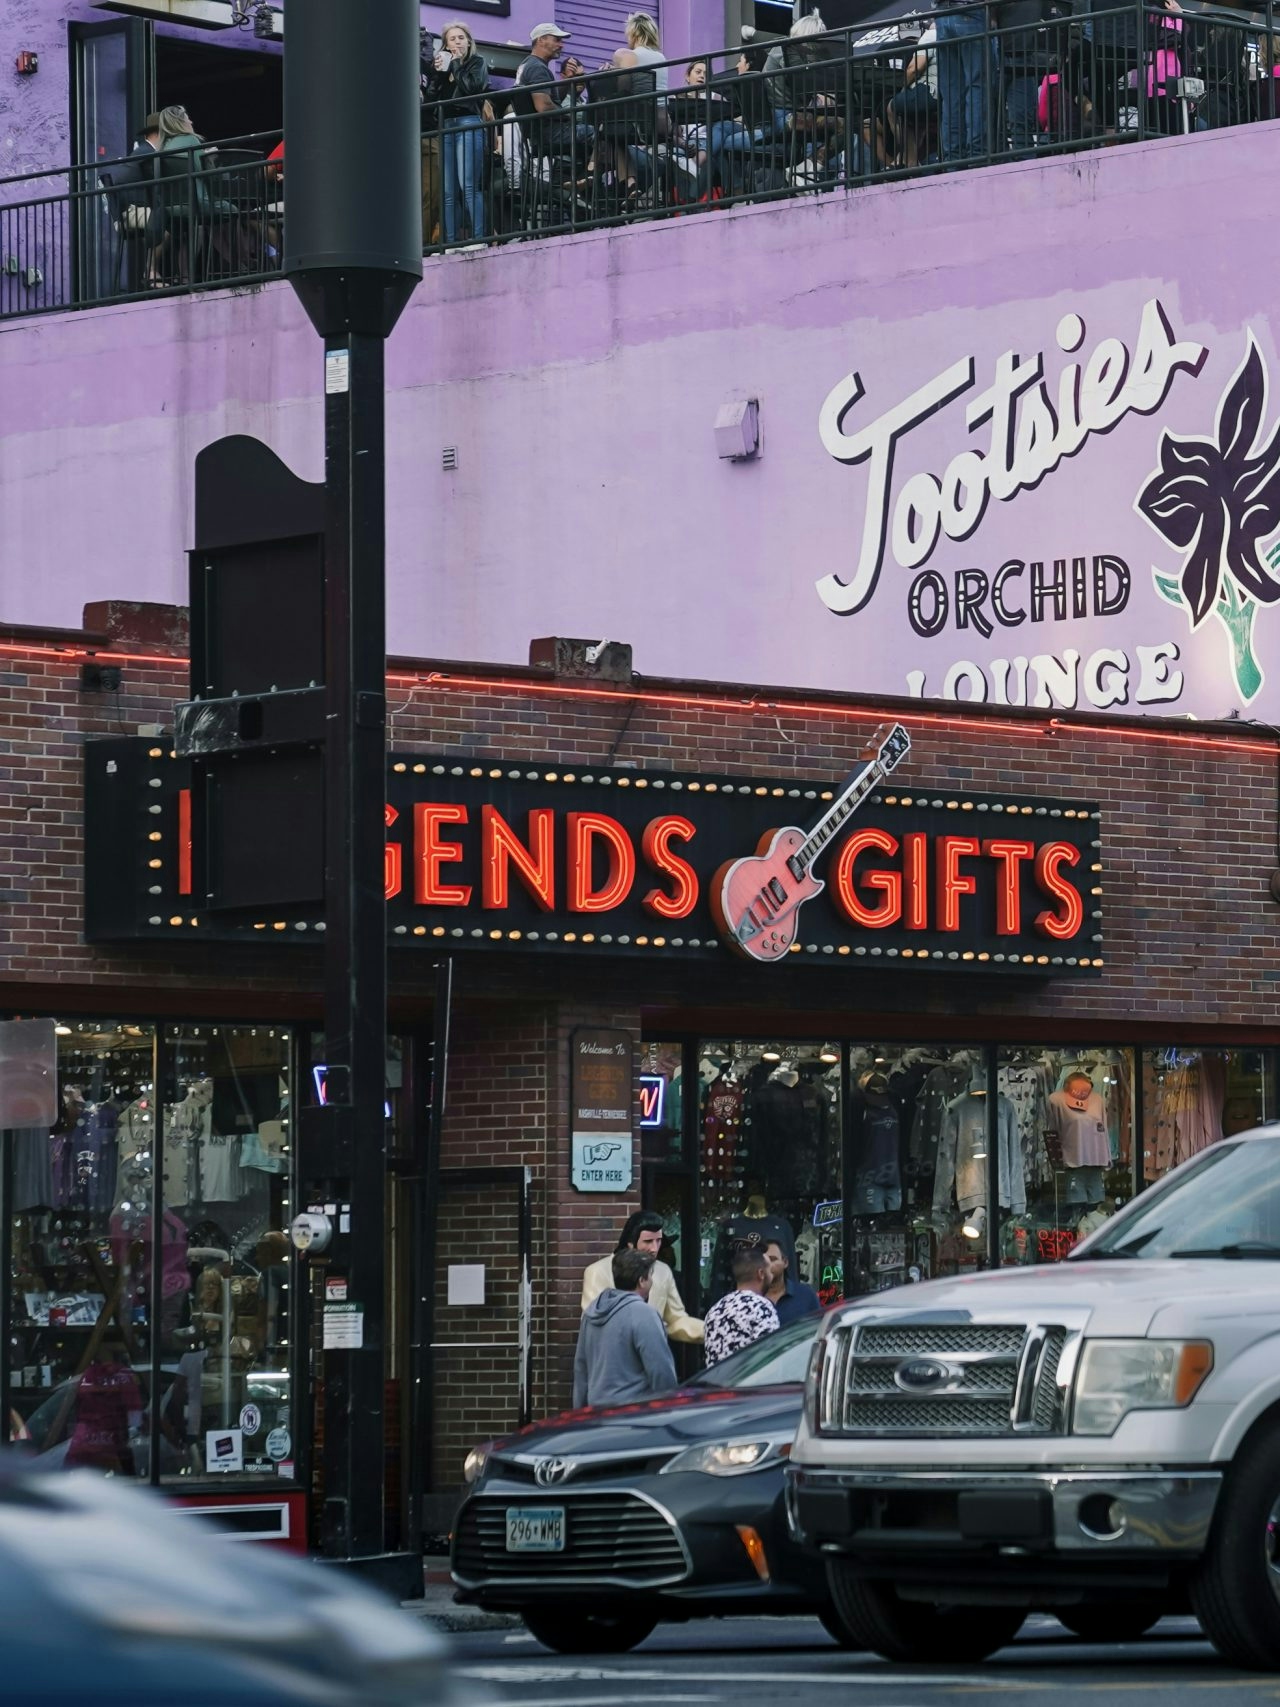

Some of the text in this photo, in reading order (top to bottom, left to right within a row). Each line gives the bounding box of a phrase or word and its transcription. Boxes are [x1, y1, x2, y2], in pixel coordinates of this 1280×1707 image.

[815, 298, 1209, 616] Tootsies
[907, 554, 1132, 639] ORCHID
[829, 827, 1083, 940] GIFTS
[580, 1041, 613, 1055] Welcome
[581, 1169, 623, 1182] ENTER HERE
